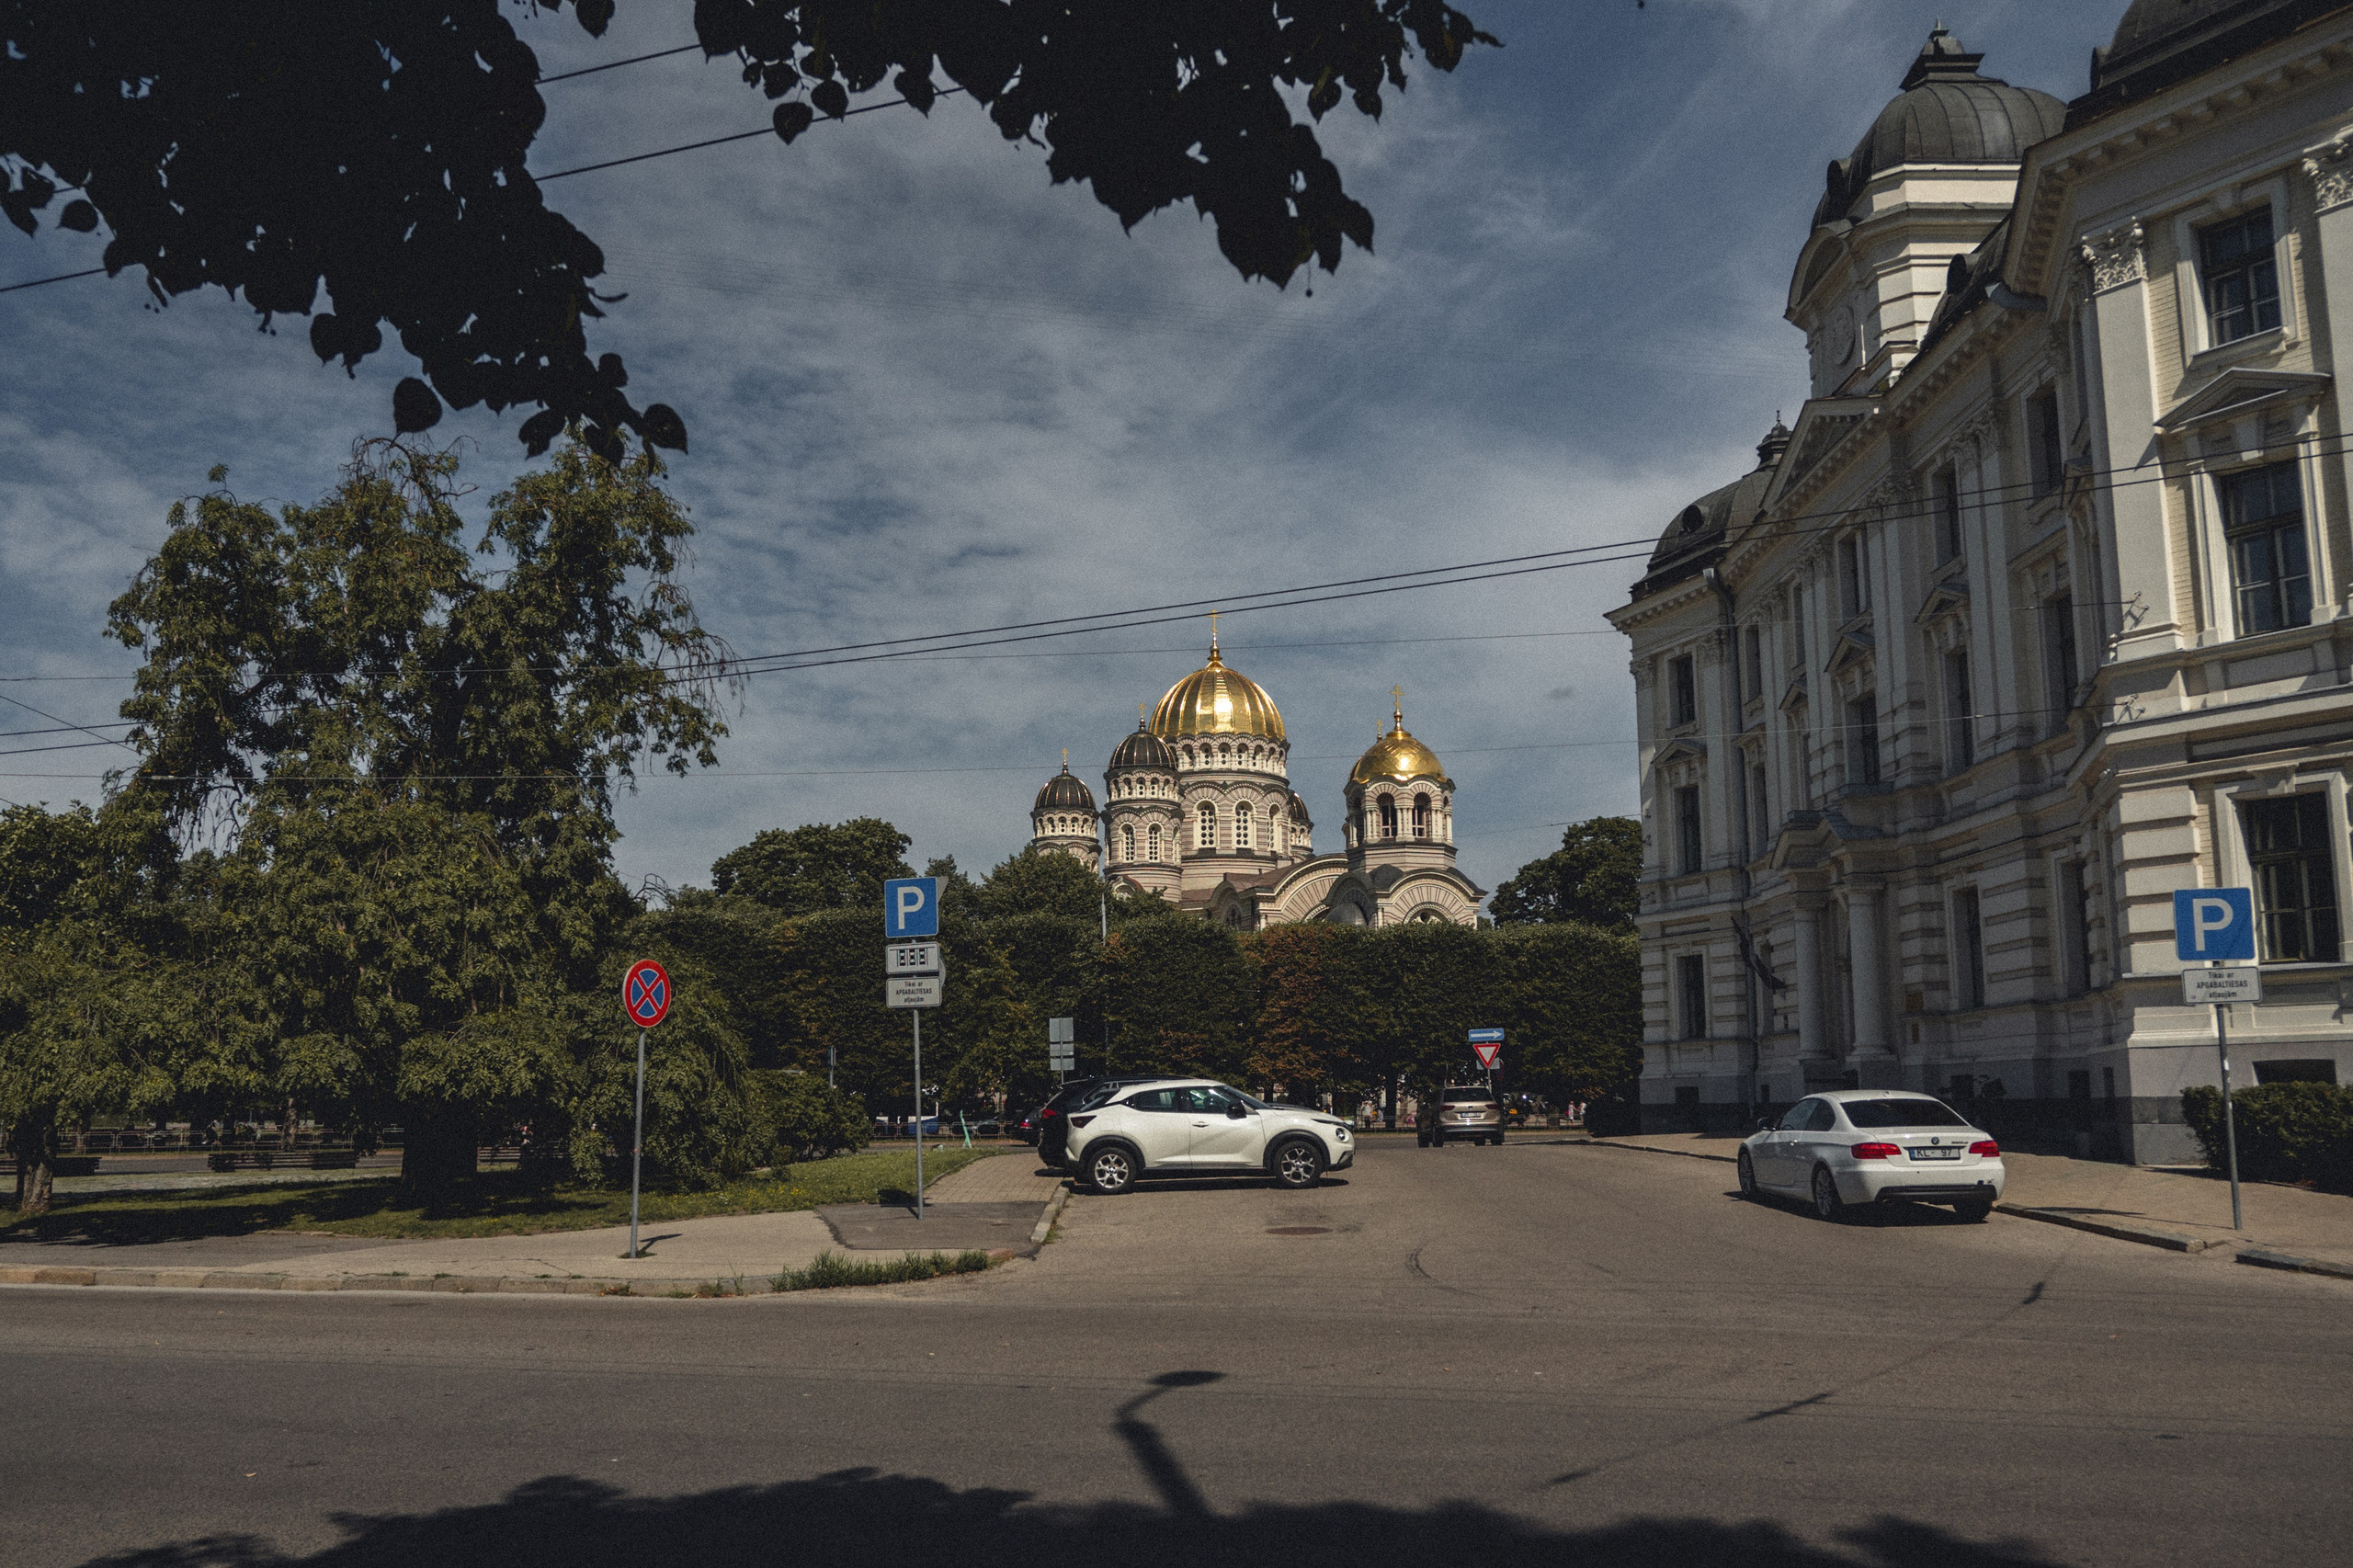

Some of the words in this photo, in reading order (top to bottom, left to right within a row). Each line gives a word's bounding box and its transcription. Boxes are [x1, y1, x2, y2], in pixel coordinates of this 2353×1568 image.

[897, 886, 925, 930] P
[2192, 898, 2234, 951] P
[2197, 980, 2247, 989] APGABALTIESAS
